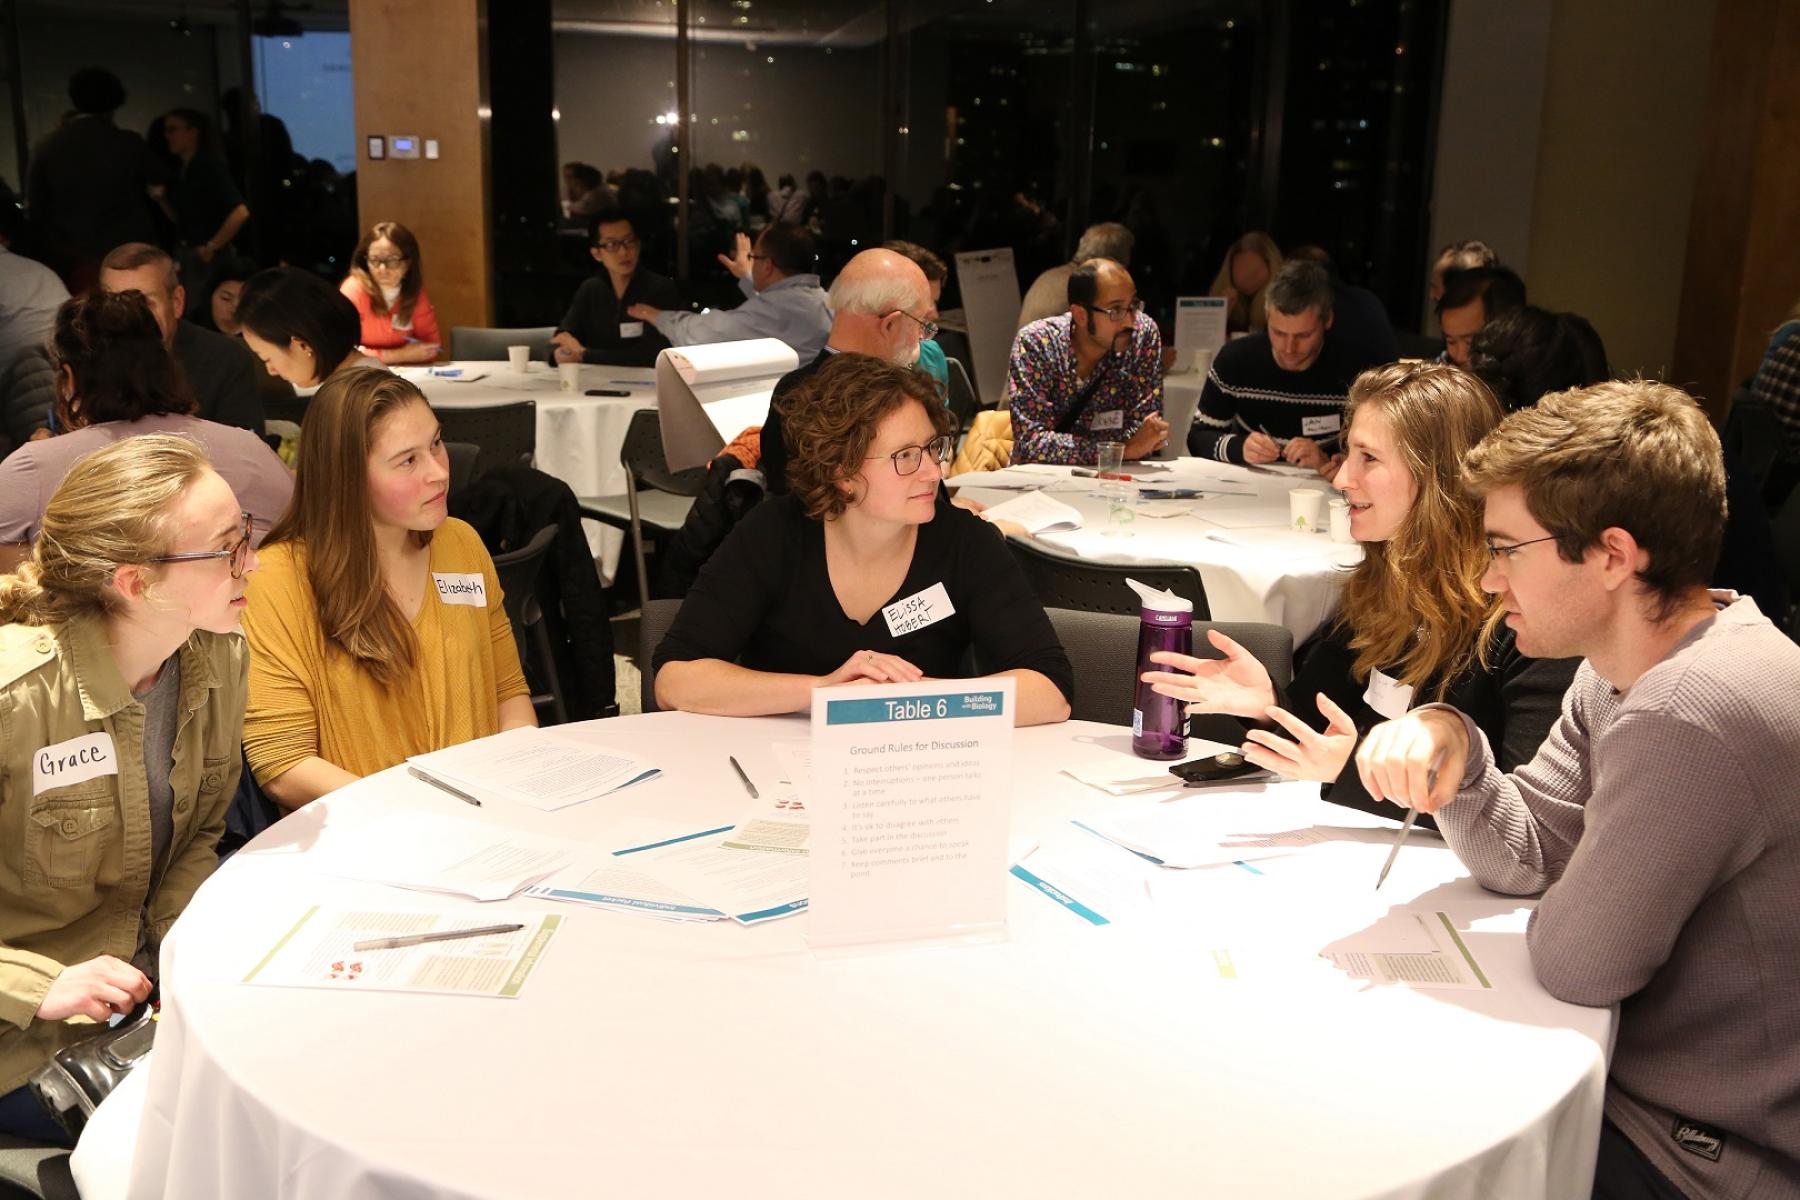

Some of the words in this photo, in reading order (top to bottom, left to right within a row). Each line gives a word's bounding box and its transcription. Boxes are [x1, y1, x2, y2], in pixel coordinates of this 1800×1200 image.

[964, 695, 992, 703] Building
[971, 702, 997, 711] Biology
[884, 700, 931, 720] Table
[936, 698, 947, 718] 6
[850, 743, 885, 756] Ground
[888, 742, 913, 753] Rules
[916, 741, 928, 751] for
[931, 739, 979, 750] Discussion
[40, 746, 107, 775] Grace
